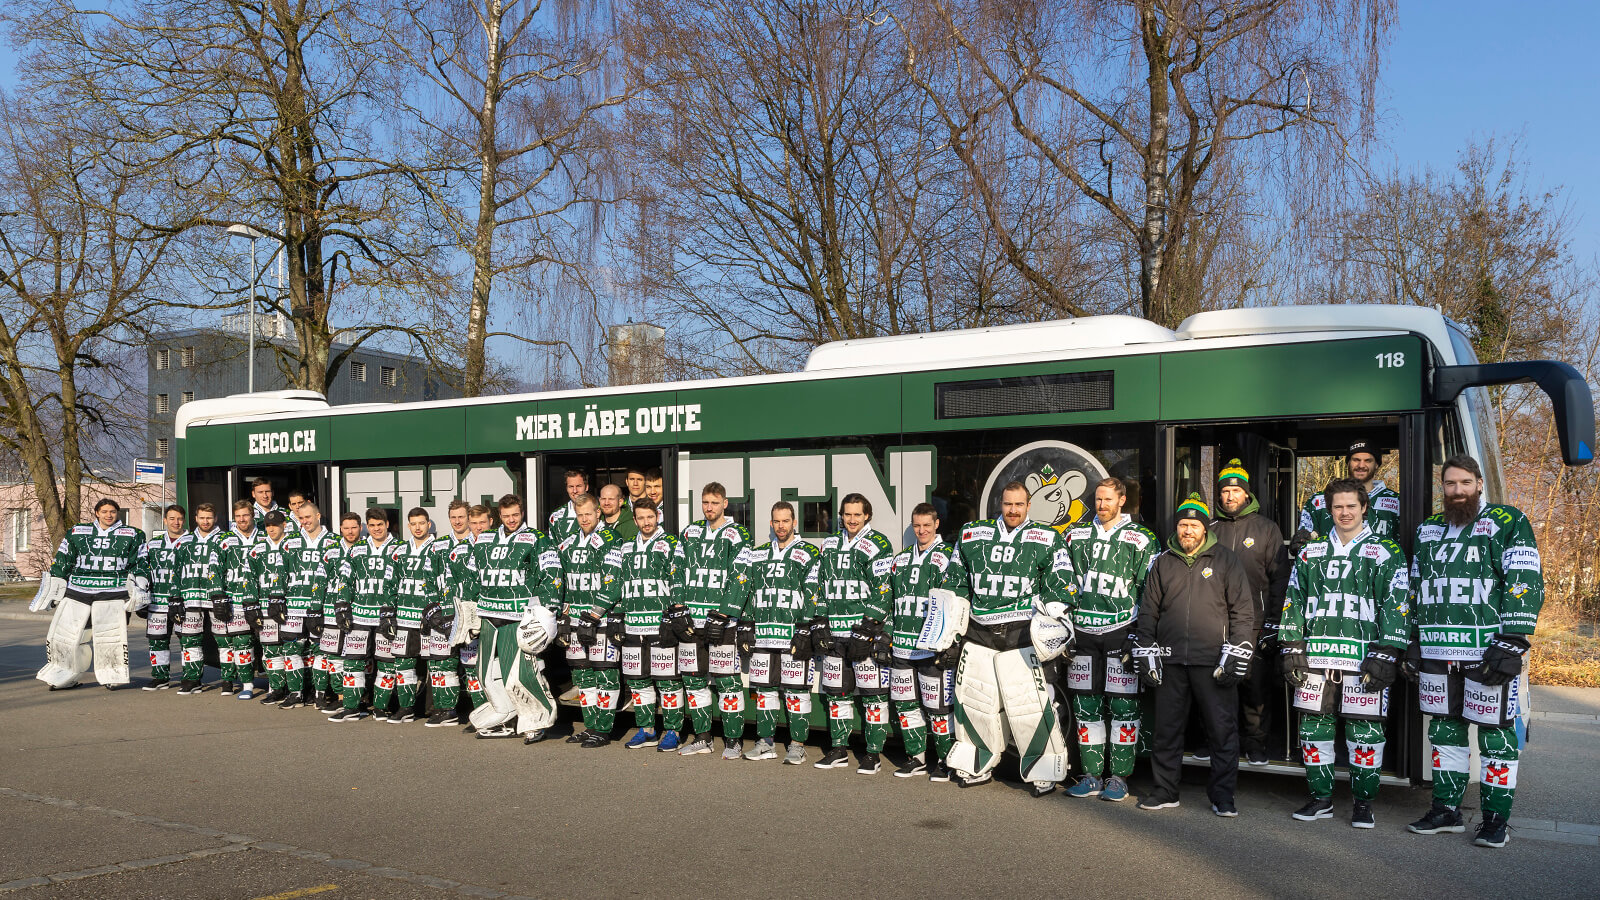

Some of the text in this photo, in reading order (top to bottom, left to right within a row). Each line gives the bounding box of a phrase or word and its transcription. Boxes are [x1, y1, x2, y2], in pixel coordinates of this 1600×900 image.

[1375, 352, 1404, 368] 118
[516, 404, 701, 440] MER LÄBE OUTE
[248, 430, 316, 454] EHCO.CH
[92, 538, 110, 549] 35
[195, 545, 208, 556] 31
[701, 543, 715, 558] 14
[1093, 542, 1111, 560] 81
[160, 551, 176, 565] 34
[302, 551, 320, 562] 66
[491, 547, 508, 560] 88
[572, 550, 588, 564] 65
[991, 545, 1015, 563] 68
[1435, 543, 1480, 563] 47 A
[368, 558, 384, 570] 93
[407, 558, 421, 570] 27
[634, 555, 647, 569] 91
[837, 553, 850, 569] 15
[181, 564, 209, 578] LTE
[766, 563, 785, 578] 25
[910, 568, 920, 584] 9
[1326, 560, 1352, 579] 67
[686, 568, 727, 589] LTE
[972, 573, 1034, 597] LTEN
[622, 579, 670, 599] LTEN
[825, 580, 872, 600] LTEN
[1417, 578, 1494, 604] LTEN
[754, 588, 804, 609] LTEN
[920, 596, 937, 643] heuberger
[710, 649, 733, 658] möbel
[710, 658, 733, 666] berger
[956, 649, 968, 686] CCM
[1030, 653, 1045, 692] CCM
[1107, 672, 1137, 687] berger
[1344, 692, 1378, 706] berger
[1464, 690, 1498, 704] möbel
[1464, 701, 1498, 714] berger
